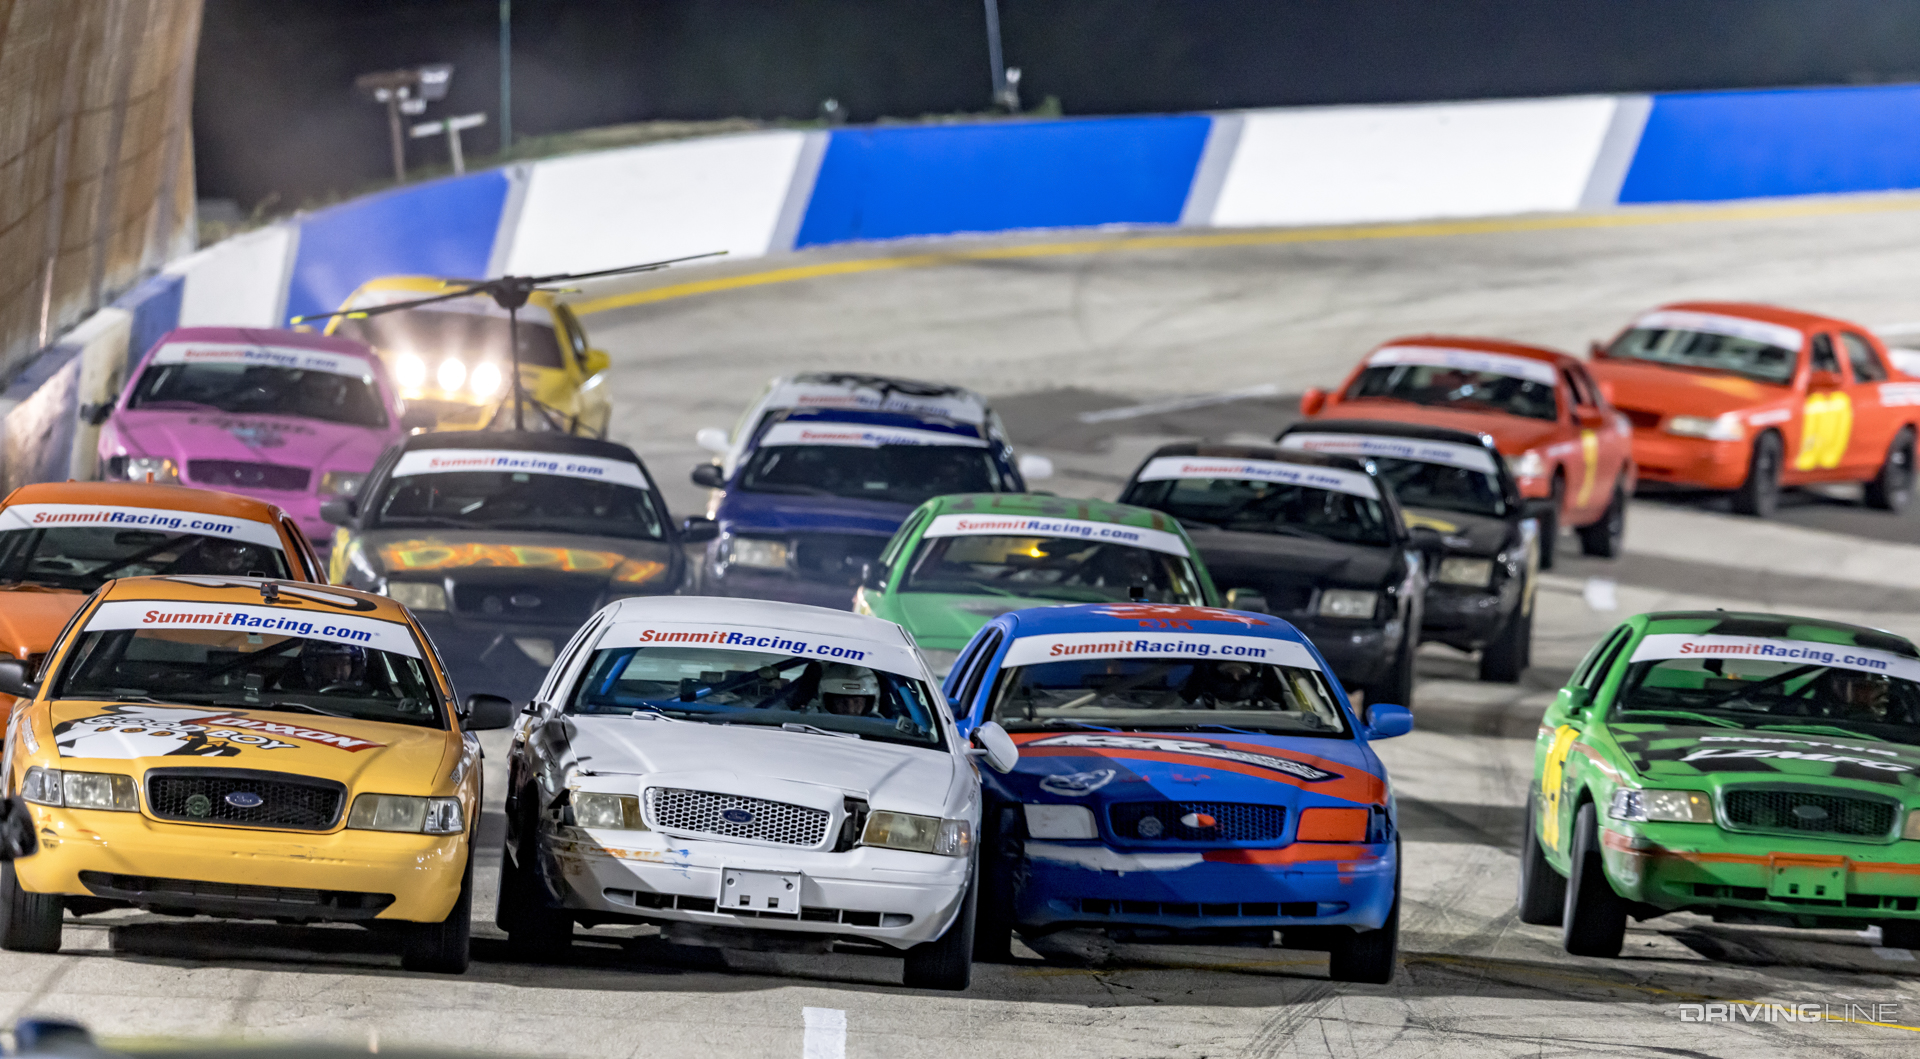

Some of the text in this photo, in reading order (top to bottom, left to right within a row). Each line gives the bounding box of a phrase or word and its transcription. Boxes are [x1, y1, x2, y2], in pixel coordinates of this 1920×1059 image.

[429, 457, 604, 475] SummitRacing.com
[33, 511, 235, 534] SummitRacing.com
[956, 519, 1140, 541] SummitRacing.com
[143, 610, 373, 642] SummitRacing.com
[639, 629, 866, 661] SummitRacing.com
[1050, 640, 1268, 658] SummitRacing.com
[1679, 642, 1888, 670] SummitRacing.com
[83, 715, 300, 750] GOOD BOY
[208, 717, 365, 748] DIXXON
